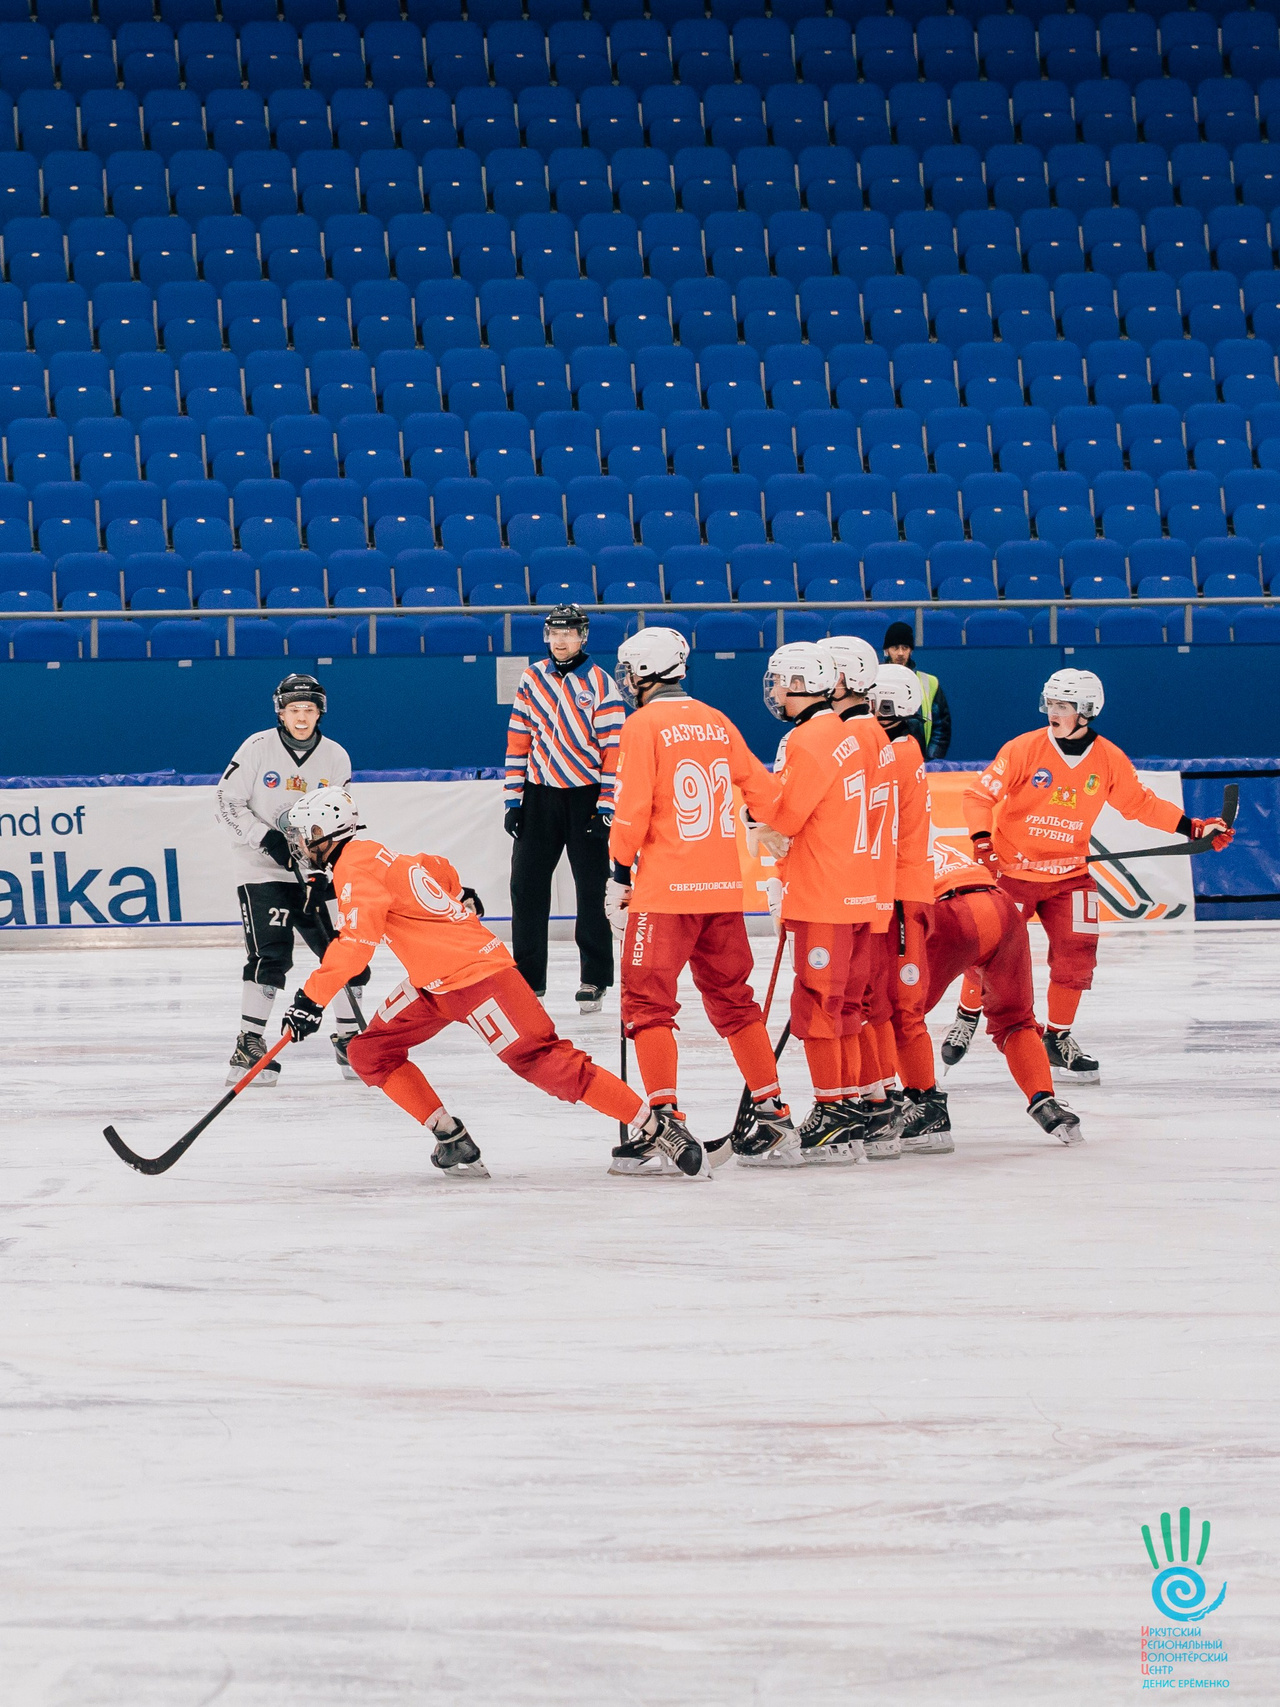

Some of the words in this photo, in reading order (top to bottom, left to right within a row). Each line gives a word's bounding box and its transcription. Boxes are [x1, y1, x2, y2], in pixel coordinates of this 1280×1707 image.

[672, 757, 737, 842] 92
[51, 805, 86, 835] of
[268, 907, 290, 927] 27
